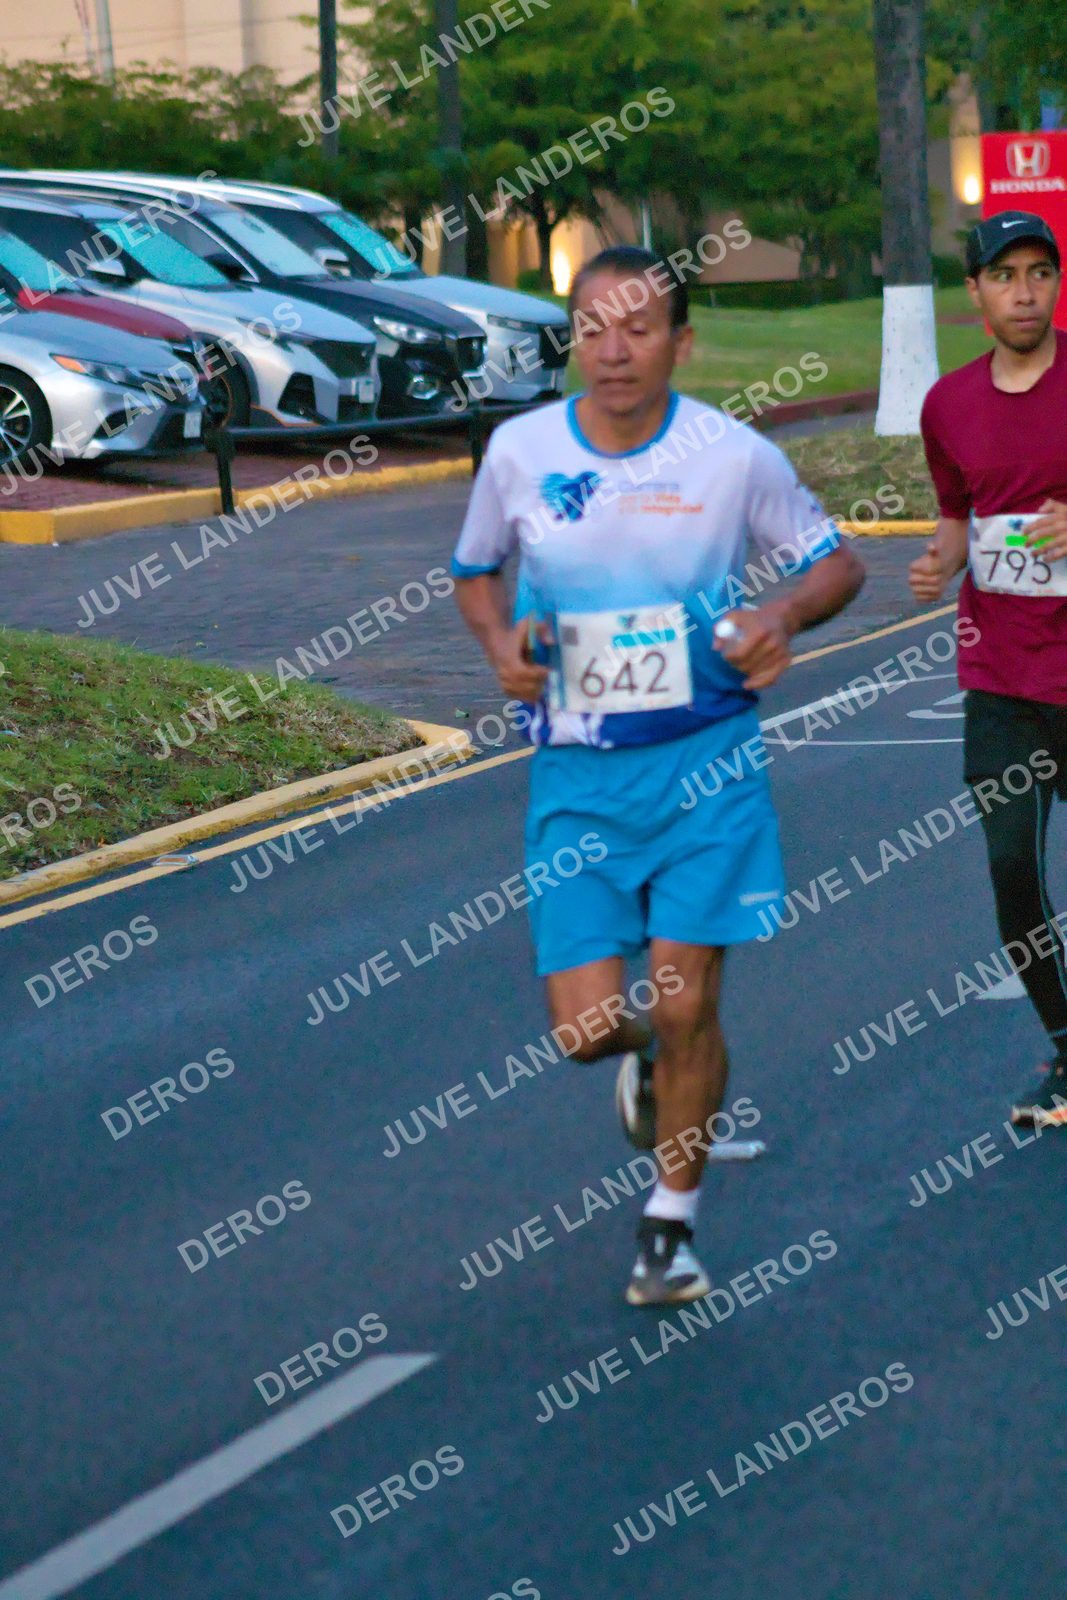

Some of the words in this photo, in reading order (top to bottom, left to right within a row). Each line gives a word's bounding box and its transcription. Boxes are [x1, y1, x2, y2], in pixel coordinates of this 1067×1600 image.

[990, 177, 1066, 195] HONDA
[980, 549, 1052, 585] 795
[579, 650, 670, 699] 642
